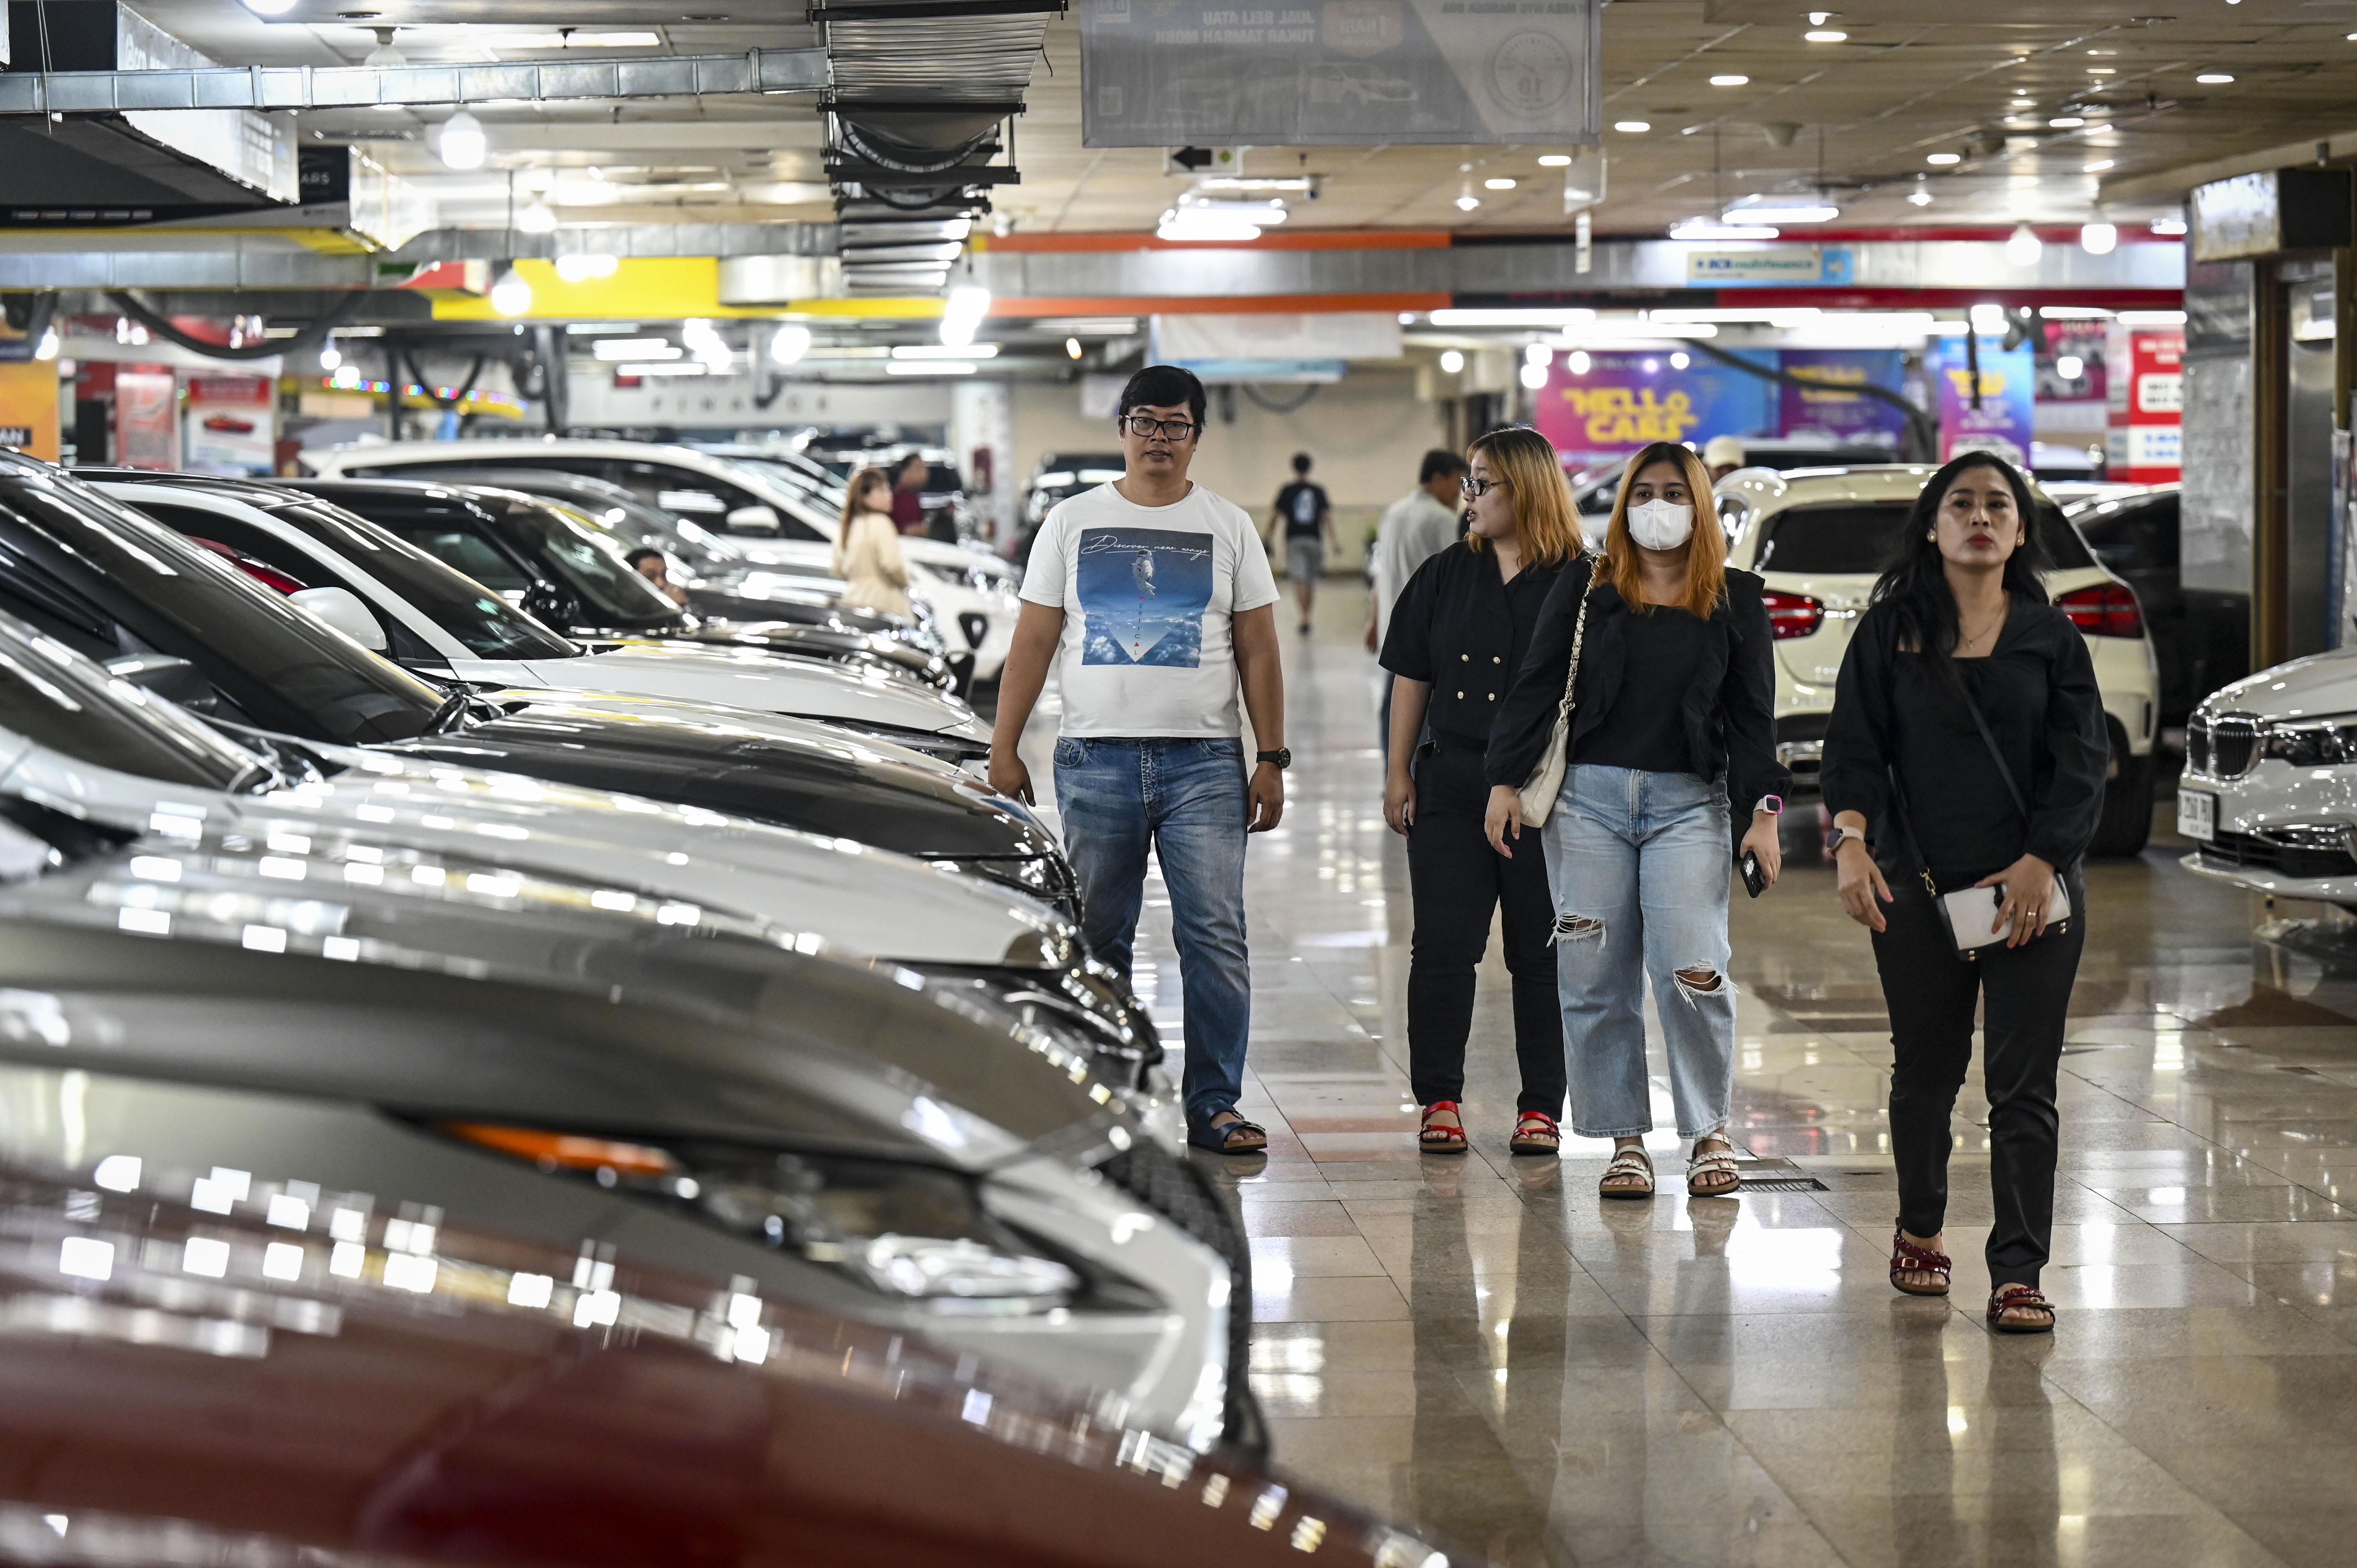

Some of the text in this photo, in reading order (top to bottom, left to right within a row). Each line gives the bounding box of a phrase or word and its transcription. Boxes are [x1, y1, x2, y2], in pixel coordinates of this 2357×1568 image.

[1562, 387, 1691, 415] HELLO
[1585, 413, 1699, 443] CARS
[1081, 534, 1149, 554] Discover
[1181, 547, 1210, 561] ways
